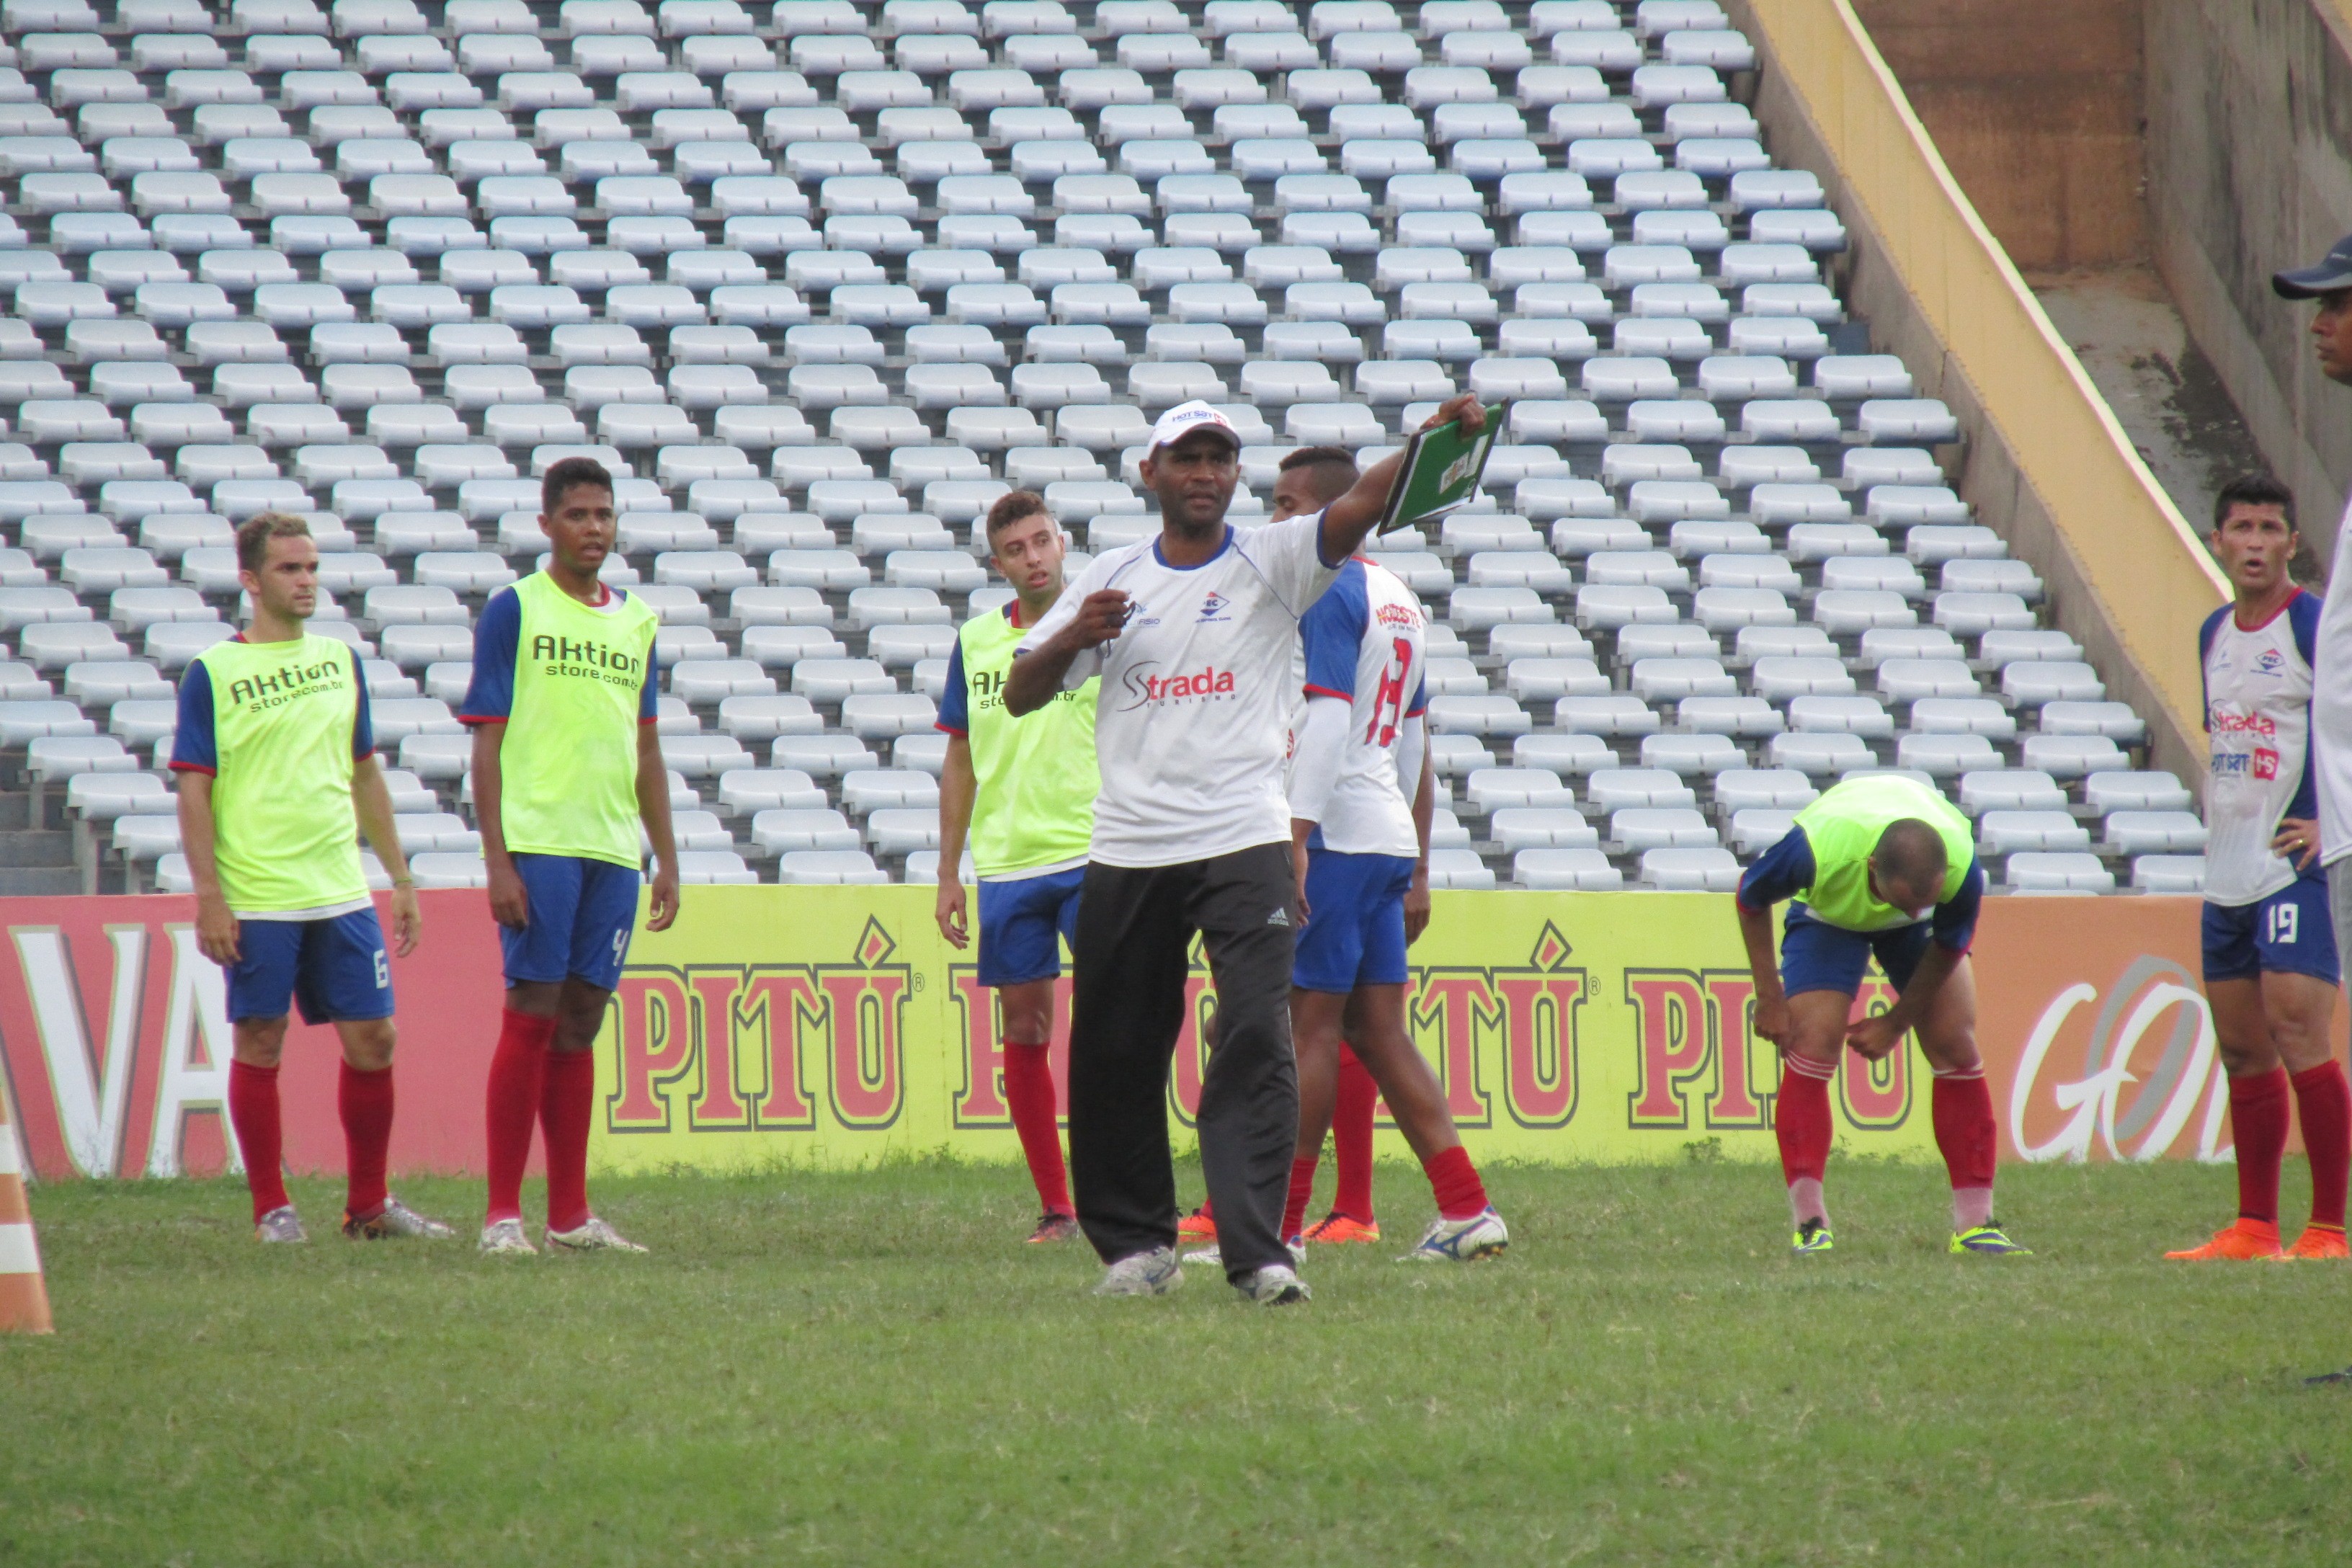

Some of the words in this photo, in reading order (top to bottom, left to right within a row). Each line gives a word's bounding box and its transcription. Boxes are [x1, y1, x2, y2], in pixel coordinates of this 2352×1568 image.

[229, 661, 339, 705] Aktion
[1118, 661, 1234, 712] Strada
[1146, 694, 1236, 708] TURISMO
[2268, 903, 2299, 943] 19
[612, 929, 629, 966] 4
[373, 949, 388, 989] 6
[606, 914, 912, 1134] PITÚ
